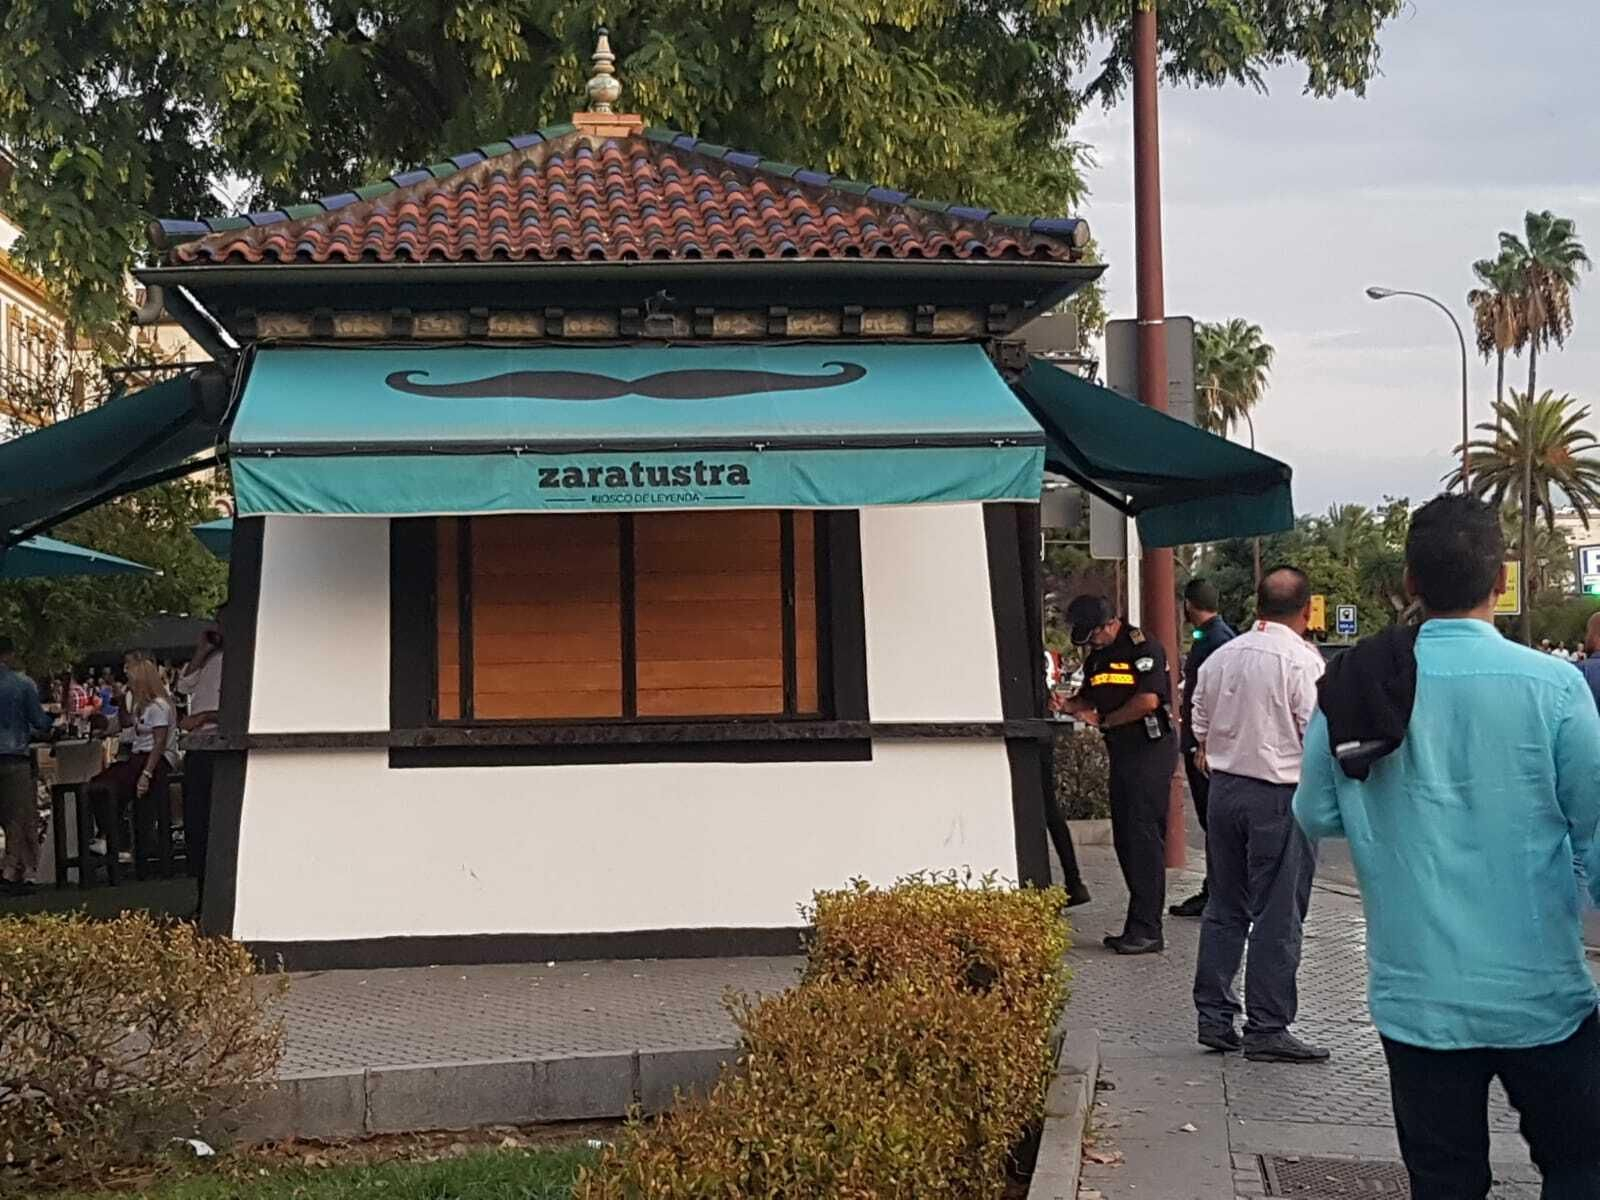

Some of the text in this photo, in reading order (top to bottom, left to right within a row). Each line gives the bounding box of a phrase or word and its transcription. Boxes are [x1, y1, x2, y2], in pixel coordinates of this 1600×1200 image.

[538, 461, 750, 488] zaratustra
[592, 491, 699, 504] KIOSCO DE LEYENDA
